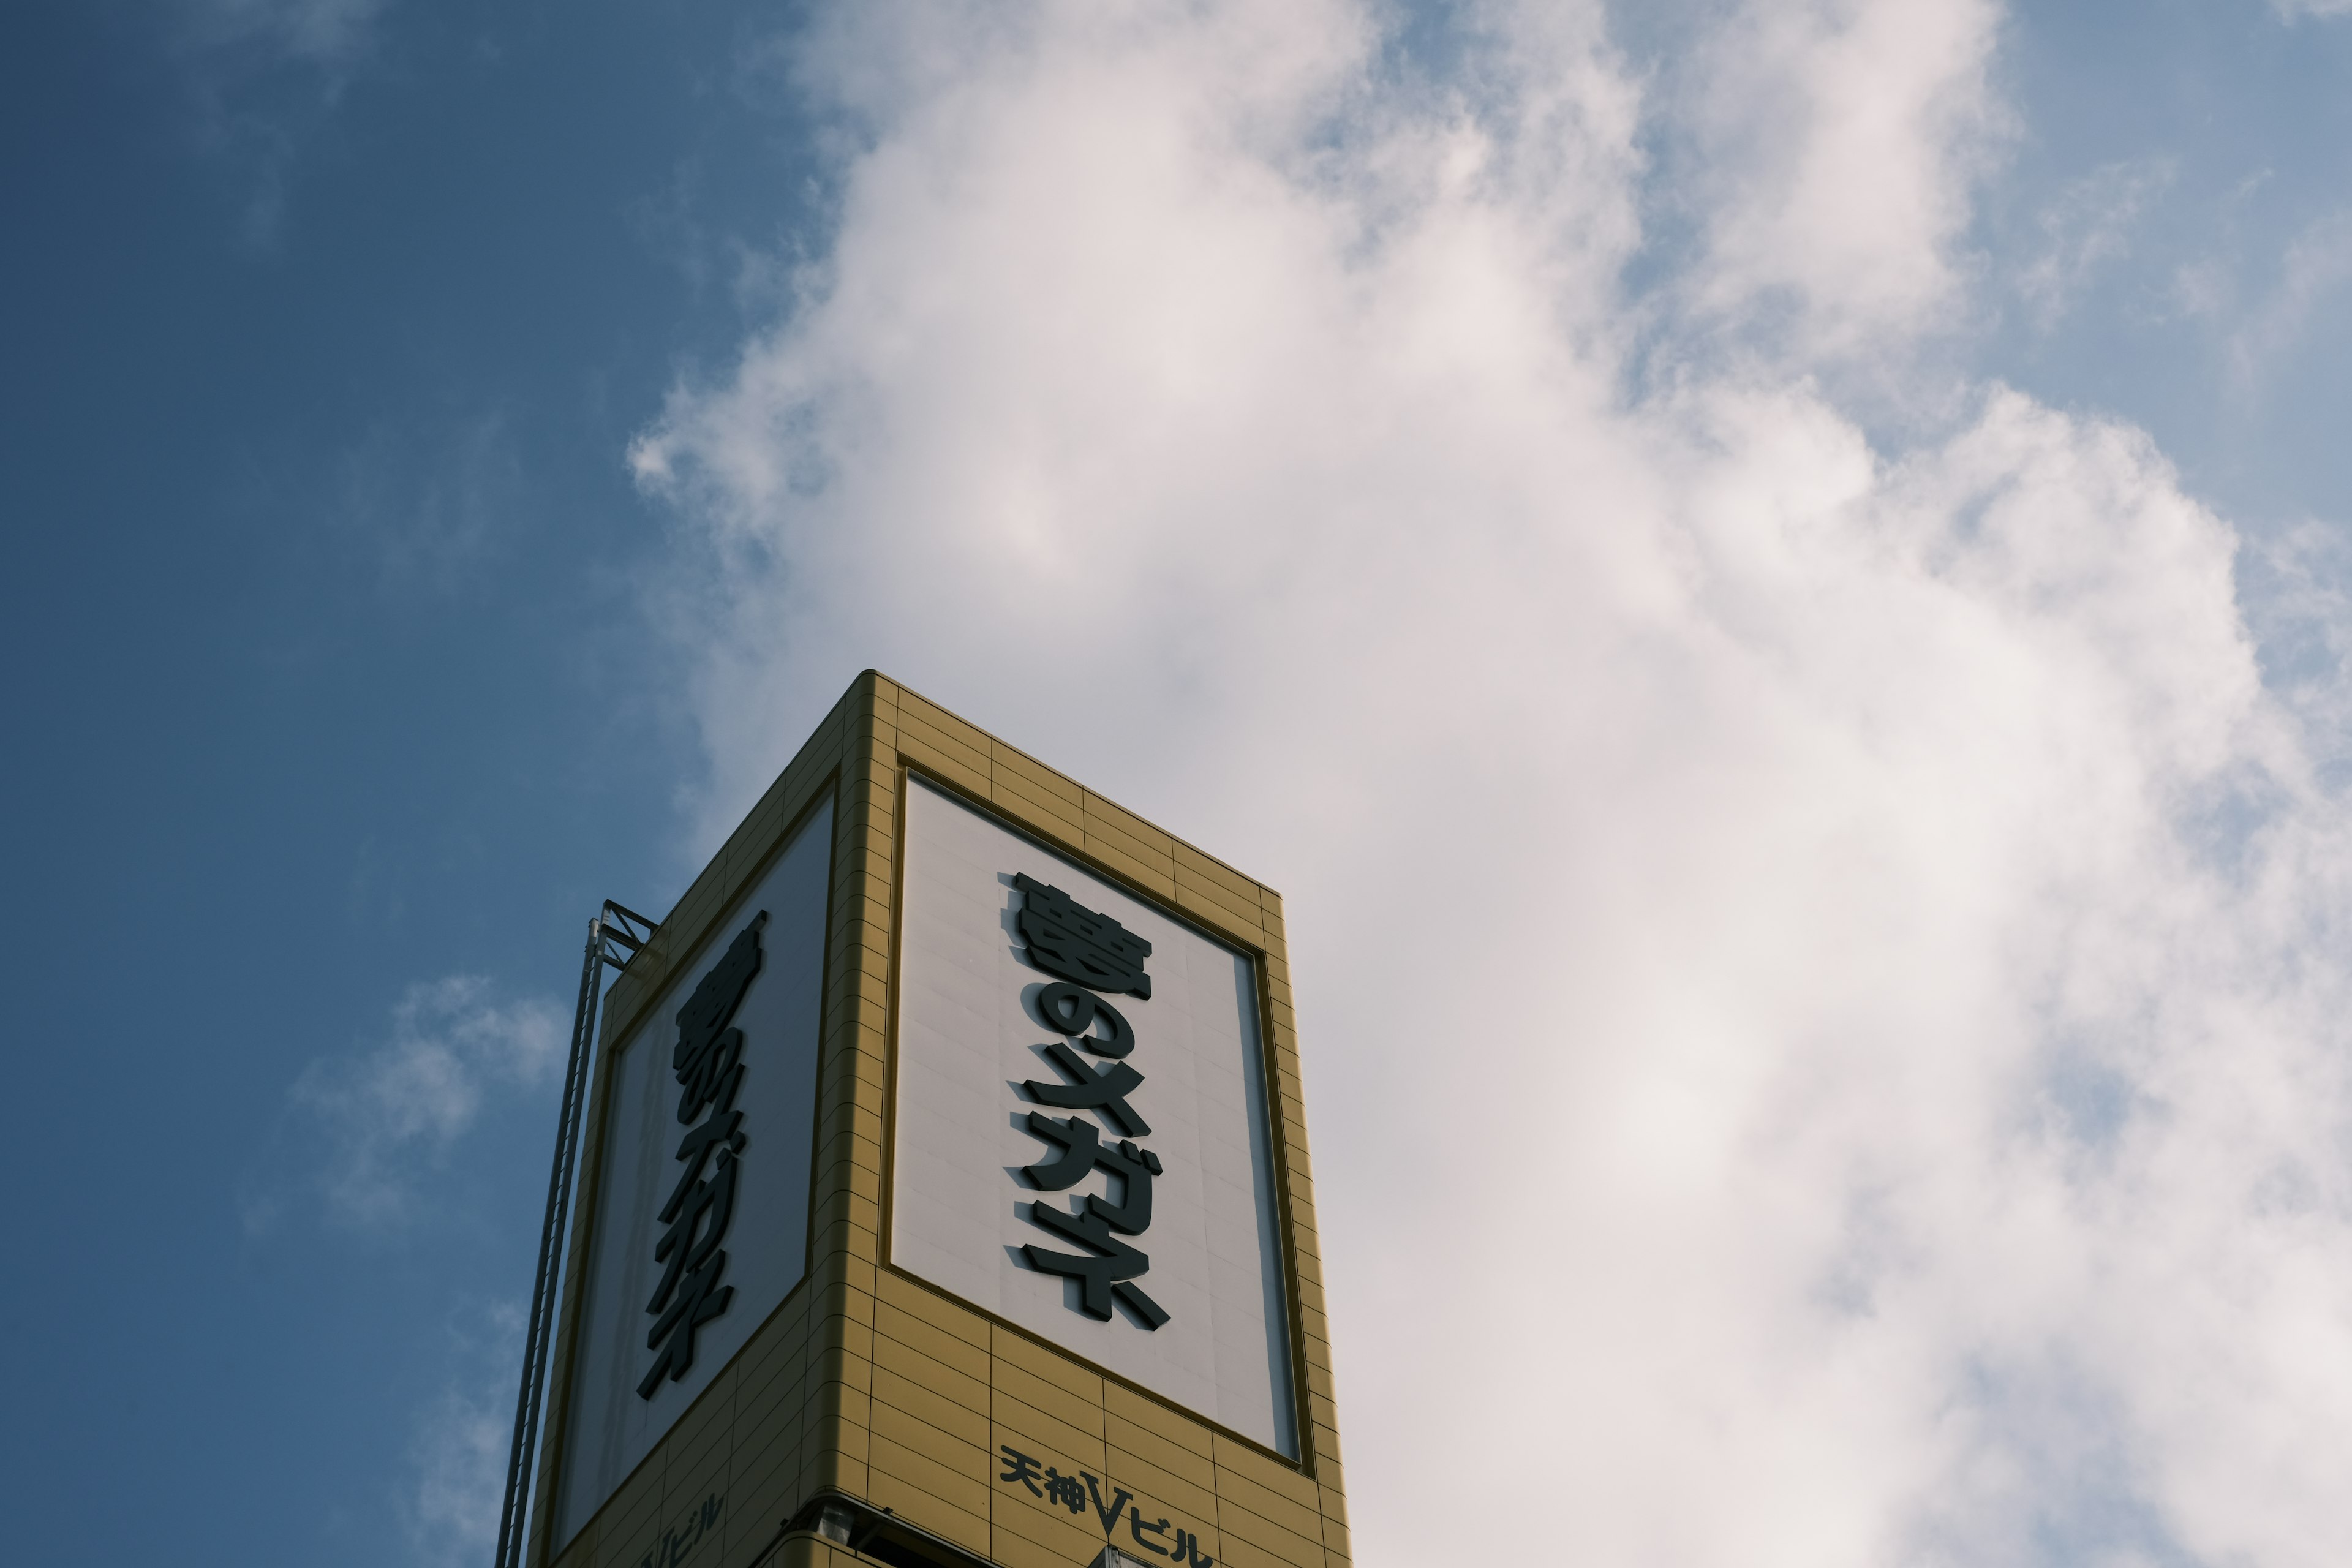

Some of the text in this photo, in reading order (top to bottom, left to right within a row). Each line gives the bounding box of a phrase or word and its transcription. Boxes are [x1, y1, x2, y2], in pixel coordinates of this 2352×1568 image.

[636, 910, 767, 1401] 夢のメガネ
[1016, 872, 1170, 1331] 夢のメガネ
[1000, 1445, 1213, 1568] 天神Vビル
